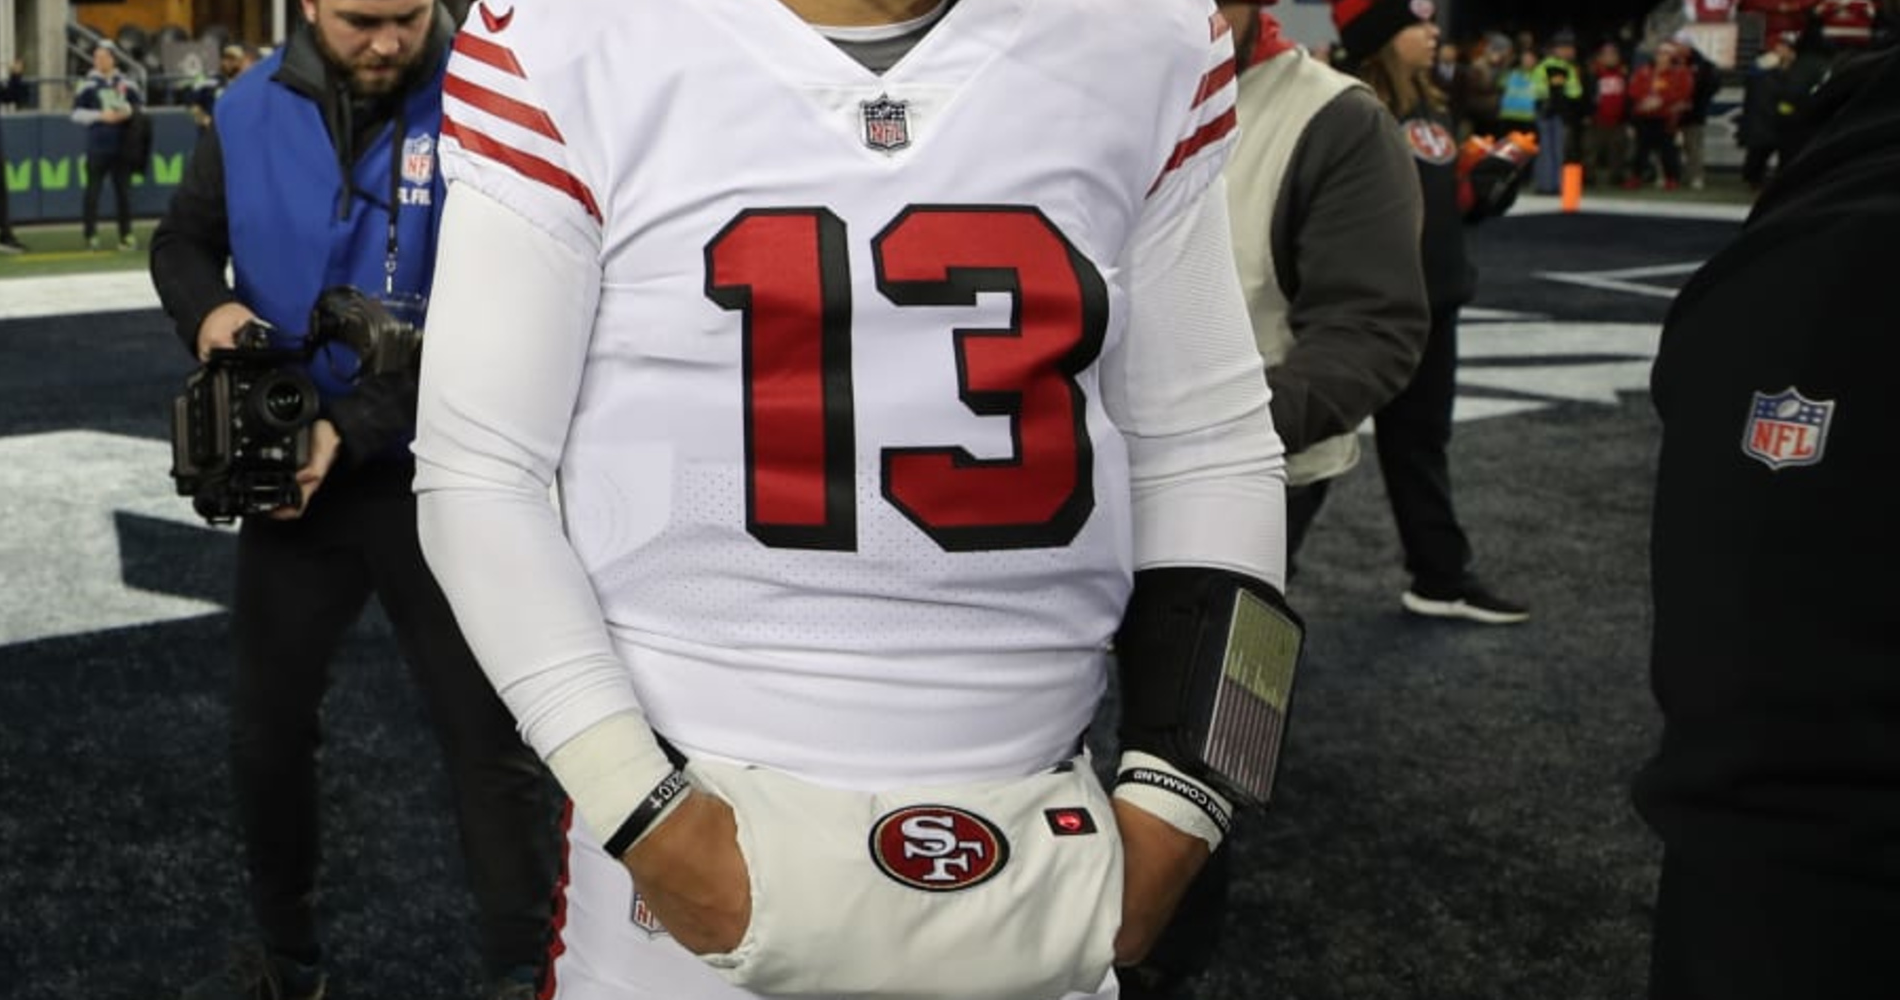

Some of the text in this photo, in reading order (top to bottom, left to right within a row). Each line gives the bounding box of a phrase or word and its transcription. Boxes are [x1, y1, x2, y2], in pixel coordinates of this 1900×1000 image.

[704, 204, 1110, 553] 13
[1751, 419, 1816, 458] NFL
[1133, 769, 1208, 805] COMMAND
[901, 815, 984, 881] SF
